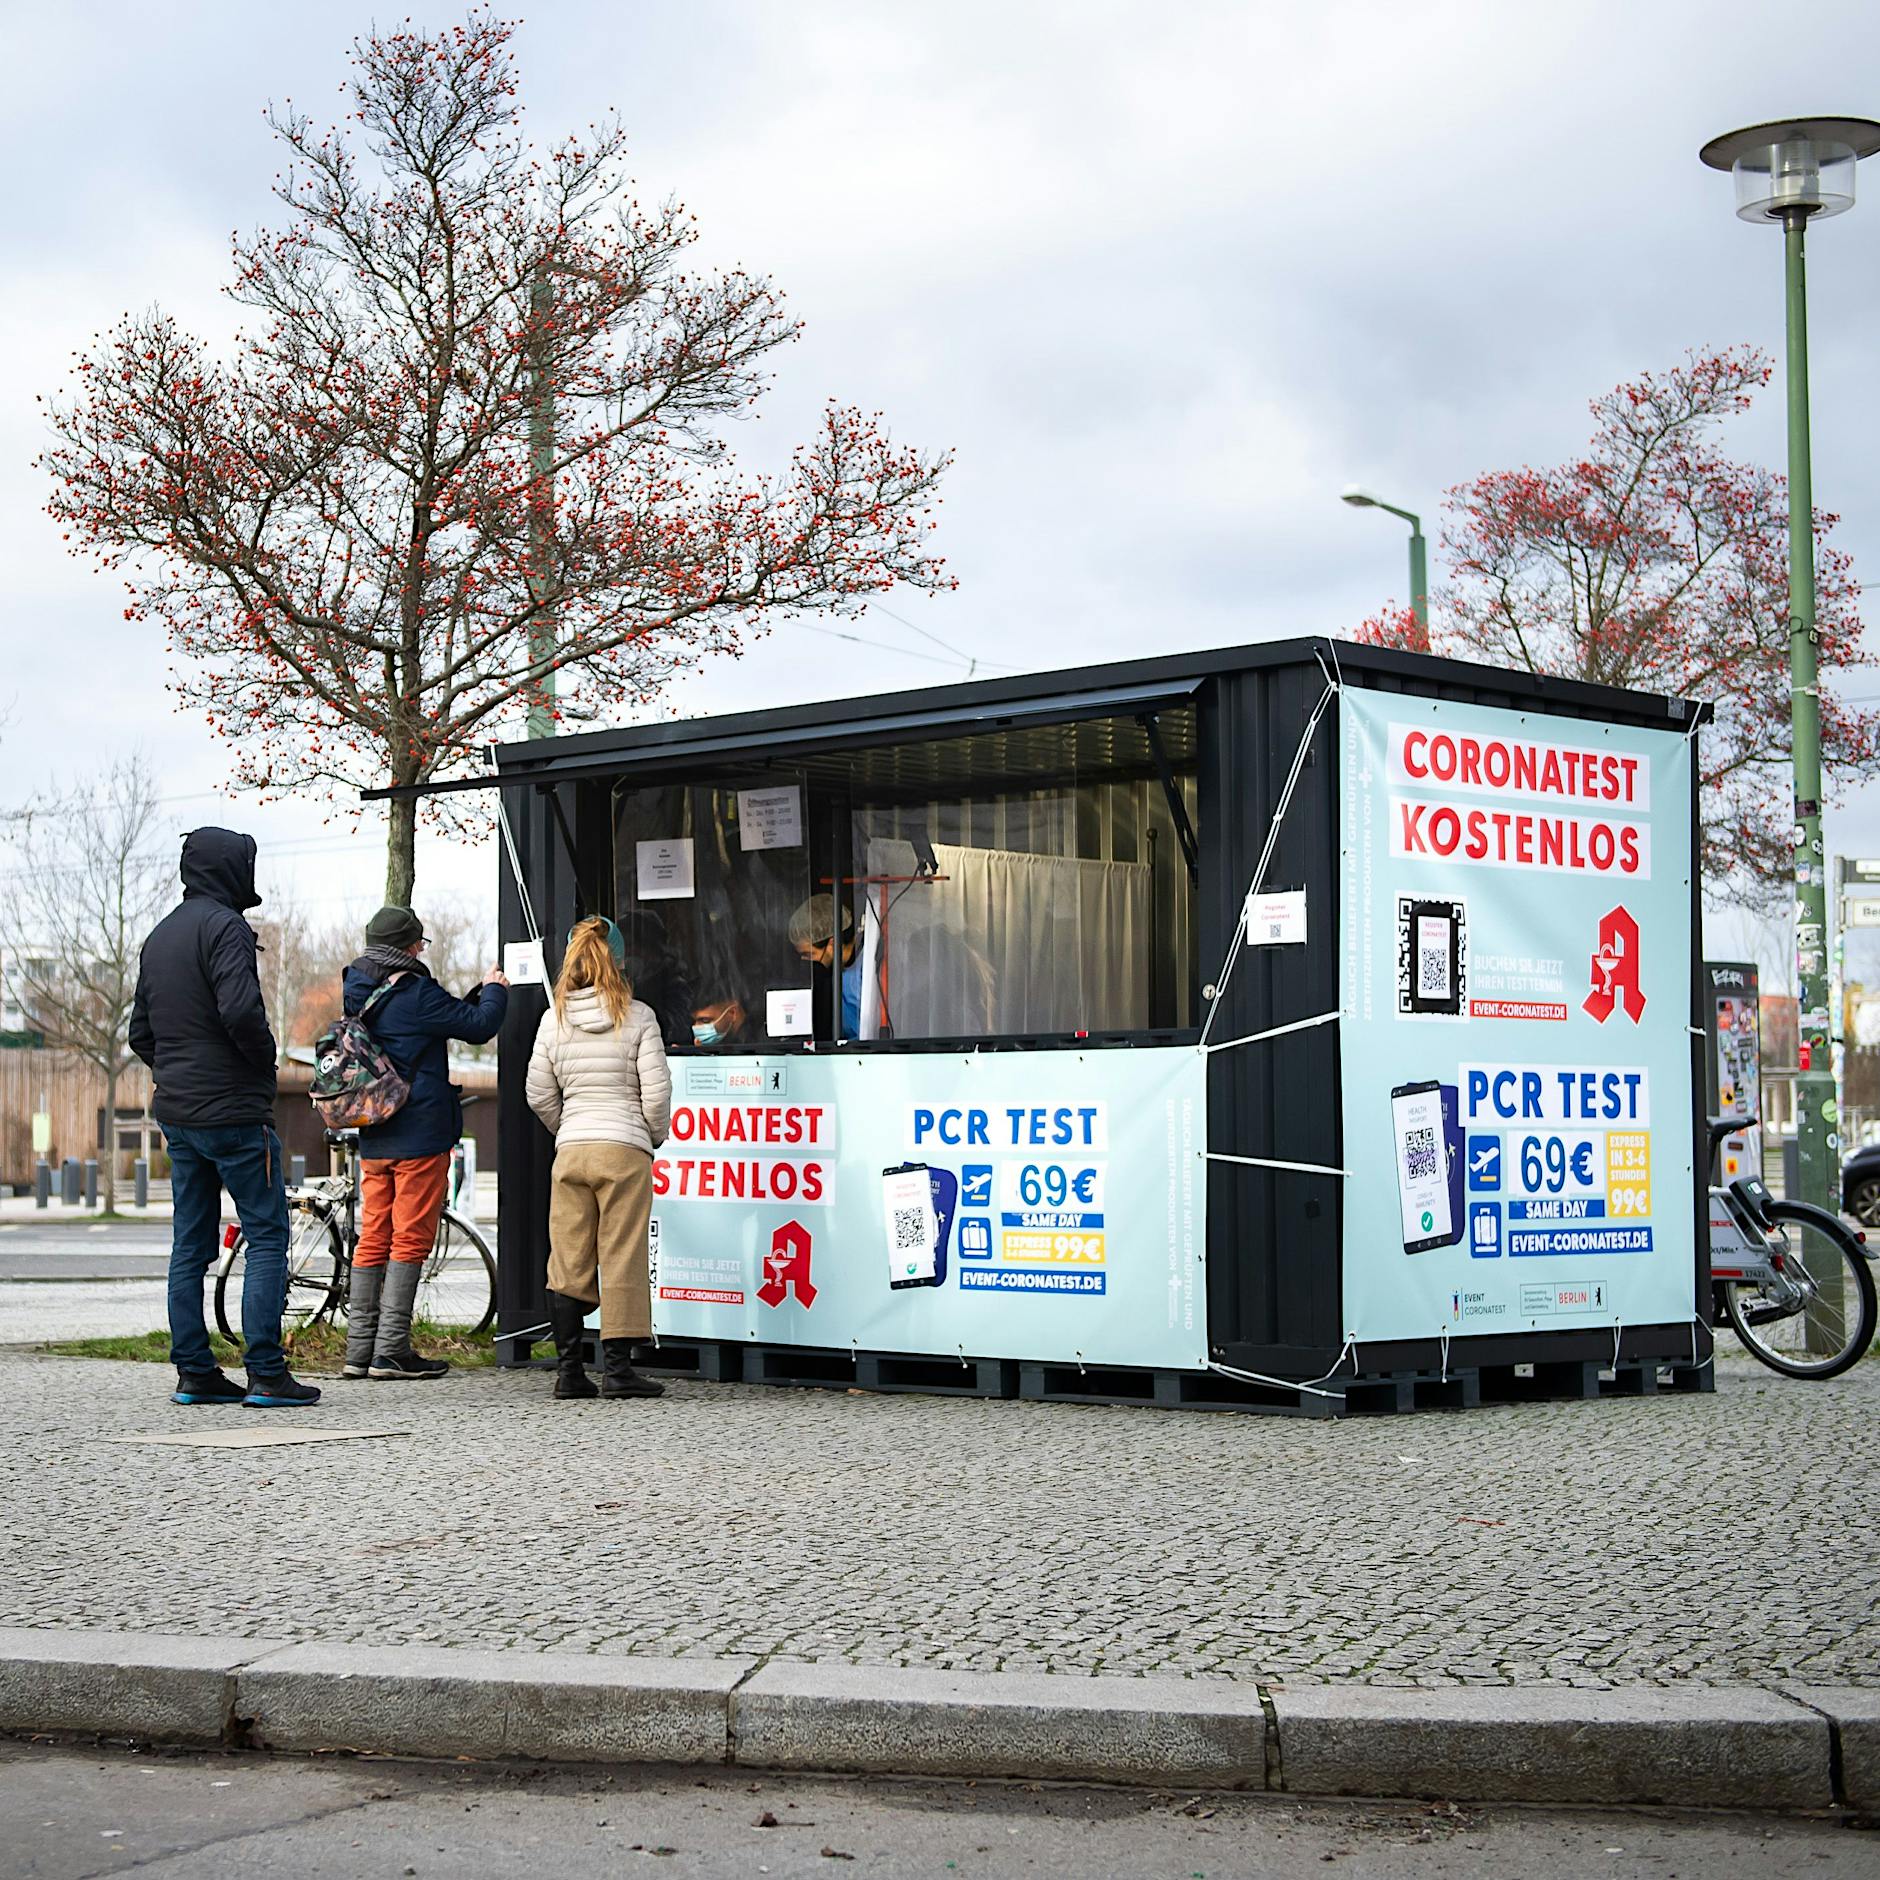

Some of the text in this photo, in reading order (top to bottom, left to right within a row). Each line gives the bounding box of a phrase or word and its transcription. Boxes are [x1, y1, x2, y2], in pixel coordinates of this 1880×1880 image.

[1403, 731, 1638, 802] CORONATEST
[1401, 804, 1640, 873] KOSTENLOS
[1474, 955, 1517, 971] BUCHEN
[1535, 960, 1564, 975] JETZT
[1474, 975, 1505, 990] IHREN
[1507, 977, 1530, 991] TEST
[1473, 1002, 1565, 1019] EVENT-CORONATEST.DE
[728, 1075, 762, 1087] BERLIN
[1468, 1070, 1543, 1118] PCR
[1557, 1073, 1641, 1119] TEST
[671, 1106, 823, 1143] ONATEST
[914, 1108, 1097, 1145] PCR TEST
[1610, 1136, 1645, 1148] EXPRESS
[1521, 1135, 1593, 1193] 69€
[1610, 1149, 1645, 1166] IN 3-6
[652, 1160, 823, 1201] STENLOS
[1610, 1169, 1646, 1181] STUNDEN
[1020, 1164, 1097, 1206] 69€
[1525, 1200, 1588, 1219] SAME DAY
[1611, 1188, 1648, 1214] 99€
[1021, 1213, 1083, 1228] SAME DAY
[1006, 1236, 1052, 1249] EXPRESS
[1054, 1236, 1101, 1260] 99€
[1512, 1230, 1649, 1253] EVENT-CORONATEST.DE
[962, 1272, 1103, 1291] EVENT-CORONATEST.DE
[662, 1289, 743, 1303] EVENT-CORONATEST.DE
[1464, 1293, 1485, 1302] EVENT
[1558, 1291, 1587, 1304] BERLIN
[1464, 1305, 1506, 1316] CORONATEST
